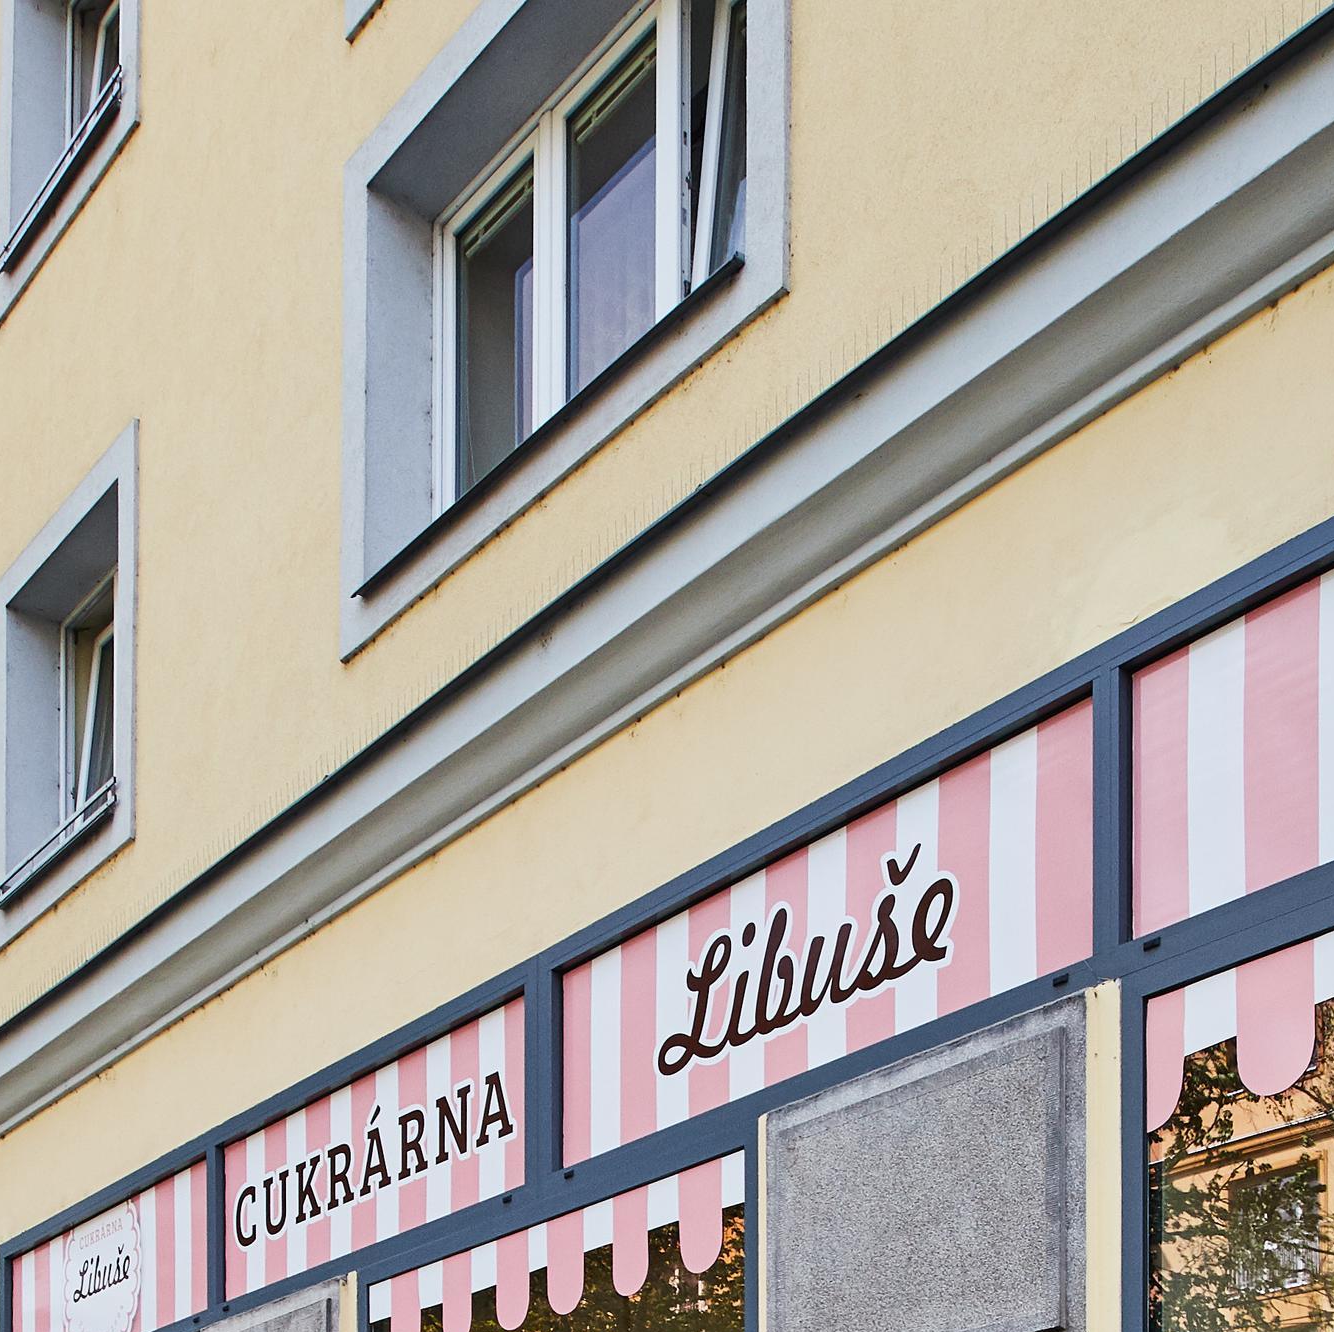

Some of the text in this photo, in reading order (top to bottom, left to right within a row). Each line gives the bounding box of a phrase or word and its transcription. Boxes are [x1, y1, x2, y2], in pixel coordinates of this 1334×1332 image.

[657, 842, 954, 1076] Libuše
[235, 1070, 514, 1248] CUKRÁRNA
[72, 1243, 131, 1304] Libuše
